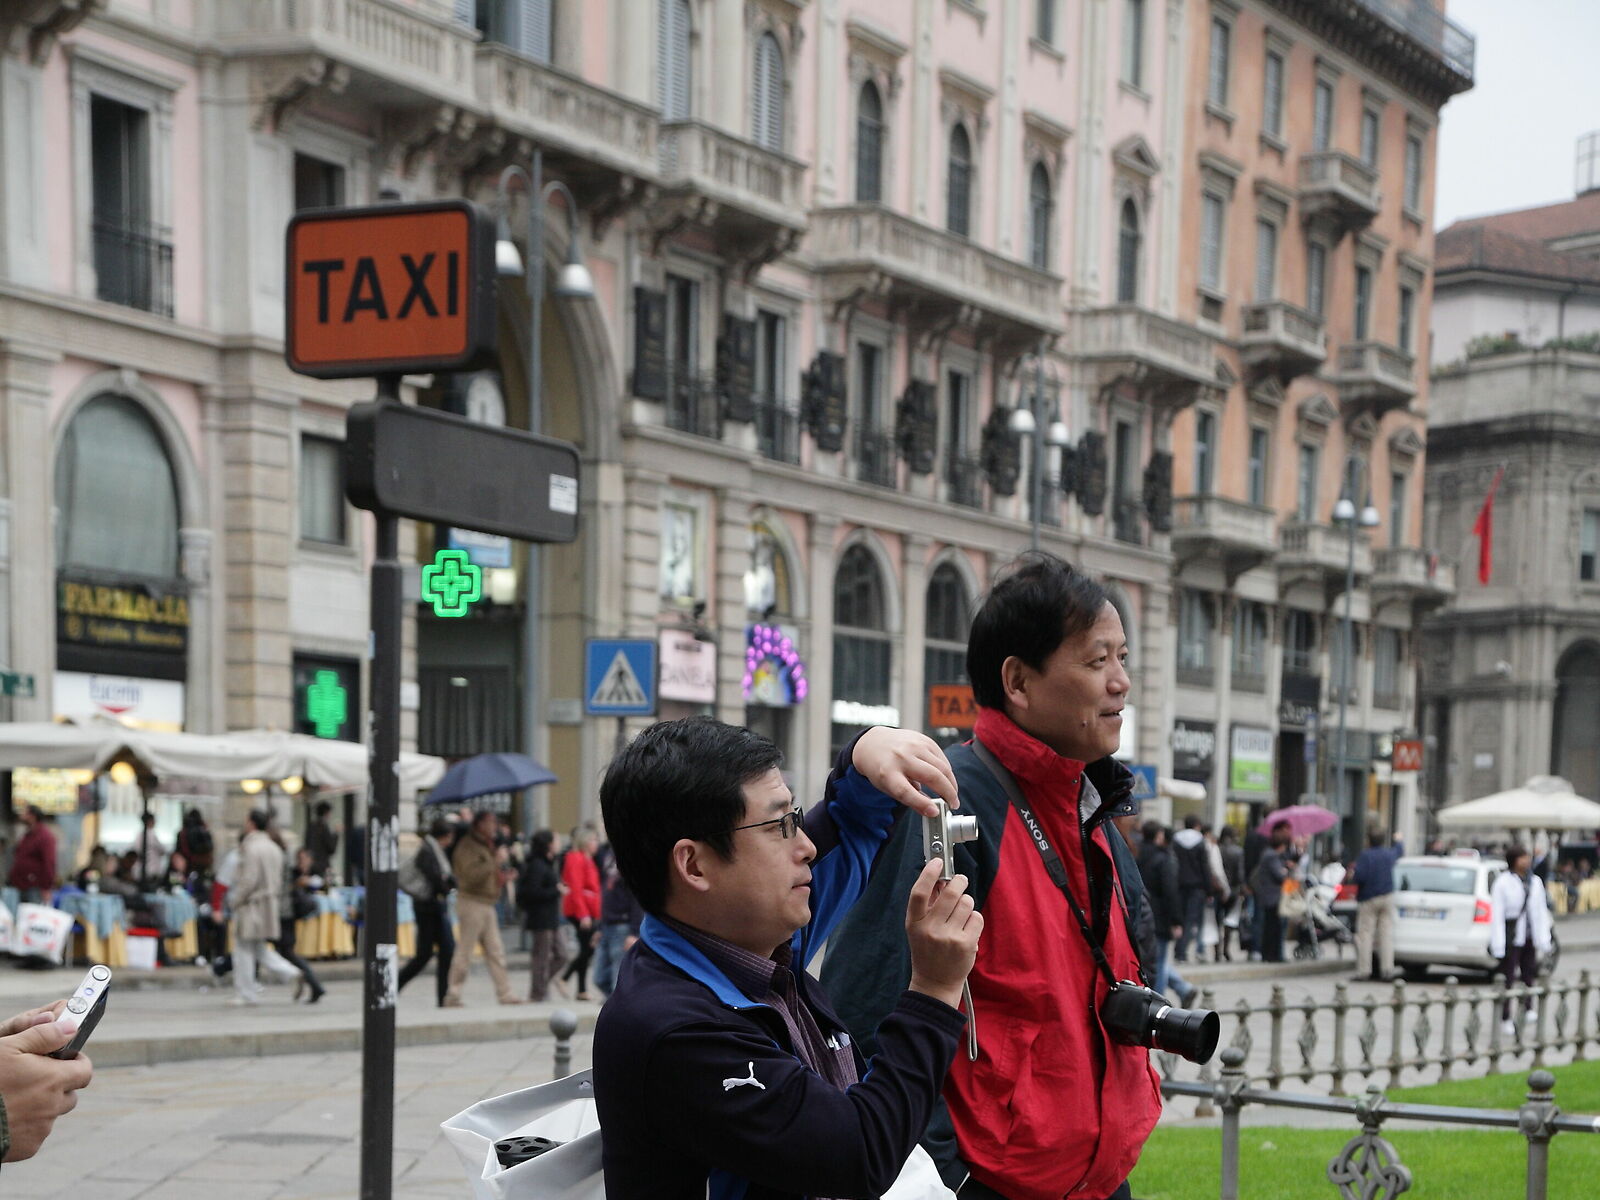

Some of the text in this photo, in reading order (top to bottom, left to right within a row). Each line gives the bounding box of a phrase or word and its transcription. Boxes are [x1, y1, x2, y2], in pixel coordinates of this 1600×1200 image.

[303, 251, 459, 325] TAXI
[64, 582, 190, 625] FARMACIA
[934, 695, 979, 716] TAX
[1020, 808, 1049, 850] SONY
